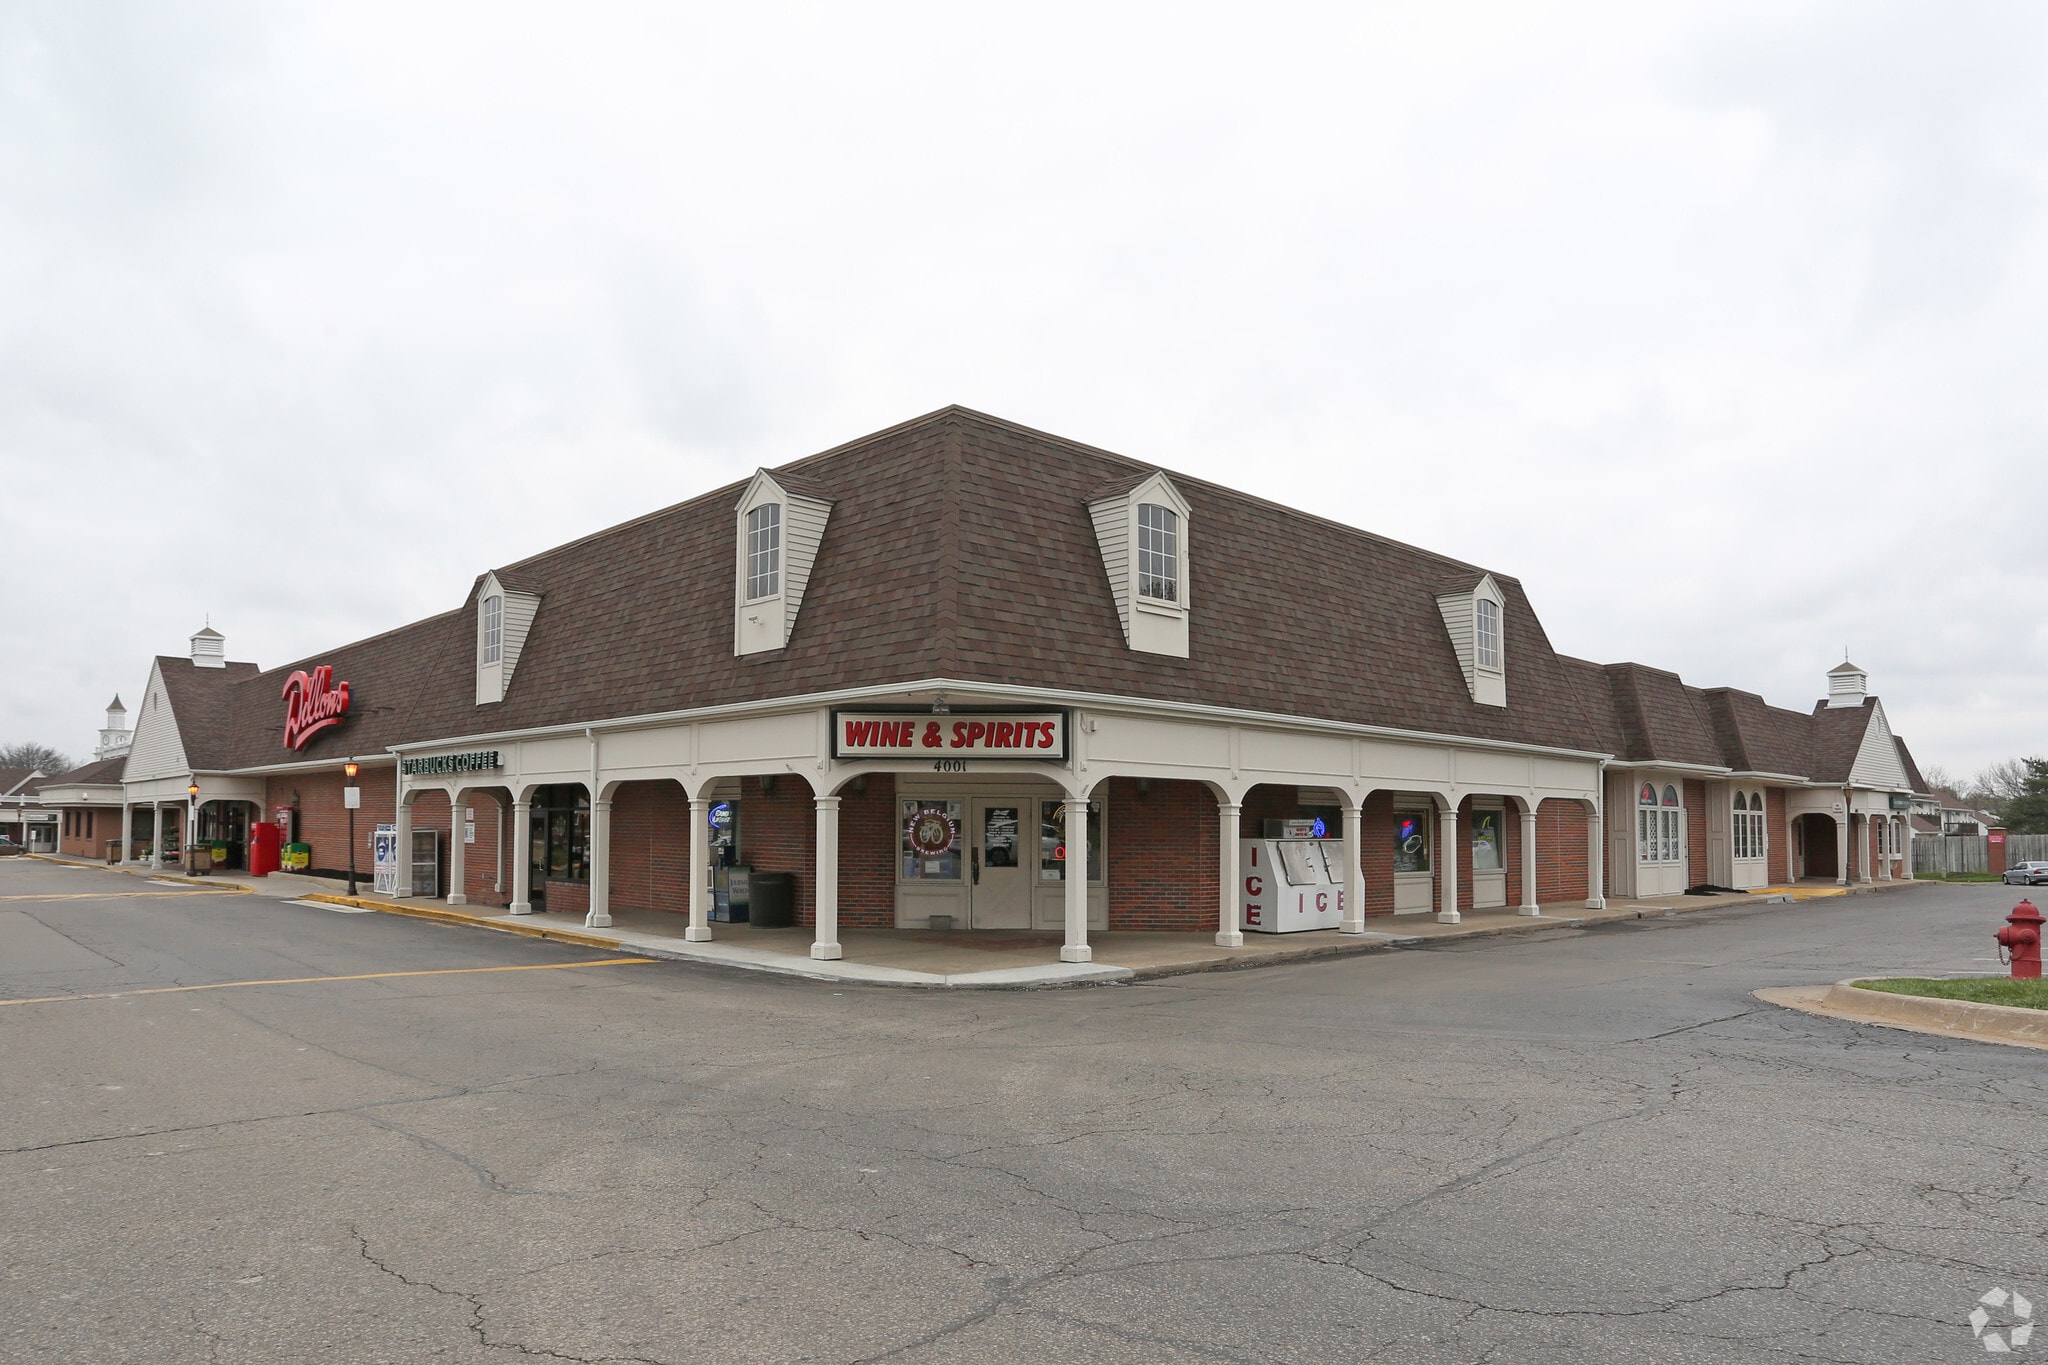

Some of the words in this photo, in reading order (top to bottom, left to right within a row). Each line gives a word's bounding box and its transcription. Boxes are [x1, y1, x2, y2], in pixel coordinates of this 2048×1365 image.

[282, 665, 349, 749] Dillons
[845, 720, 916, 747] WINE
[922, 721, 943, 748] &
[949, 721, 1056, 749] SPIRITS
[402, 755, 455, 775] STARBUCKS
[455, 751, 498, 772] COFFEE
[933, 760, 967, 772] 4001
[908, 813, 920, 833] NEW
[923, 808, 956, 834] BELGIUM
[916, 846, 949, 855] BREWING
[1245, 847, 1263, 926] ICE
